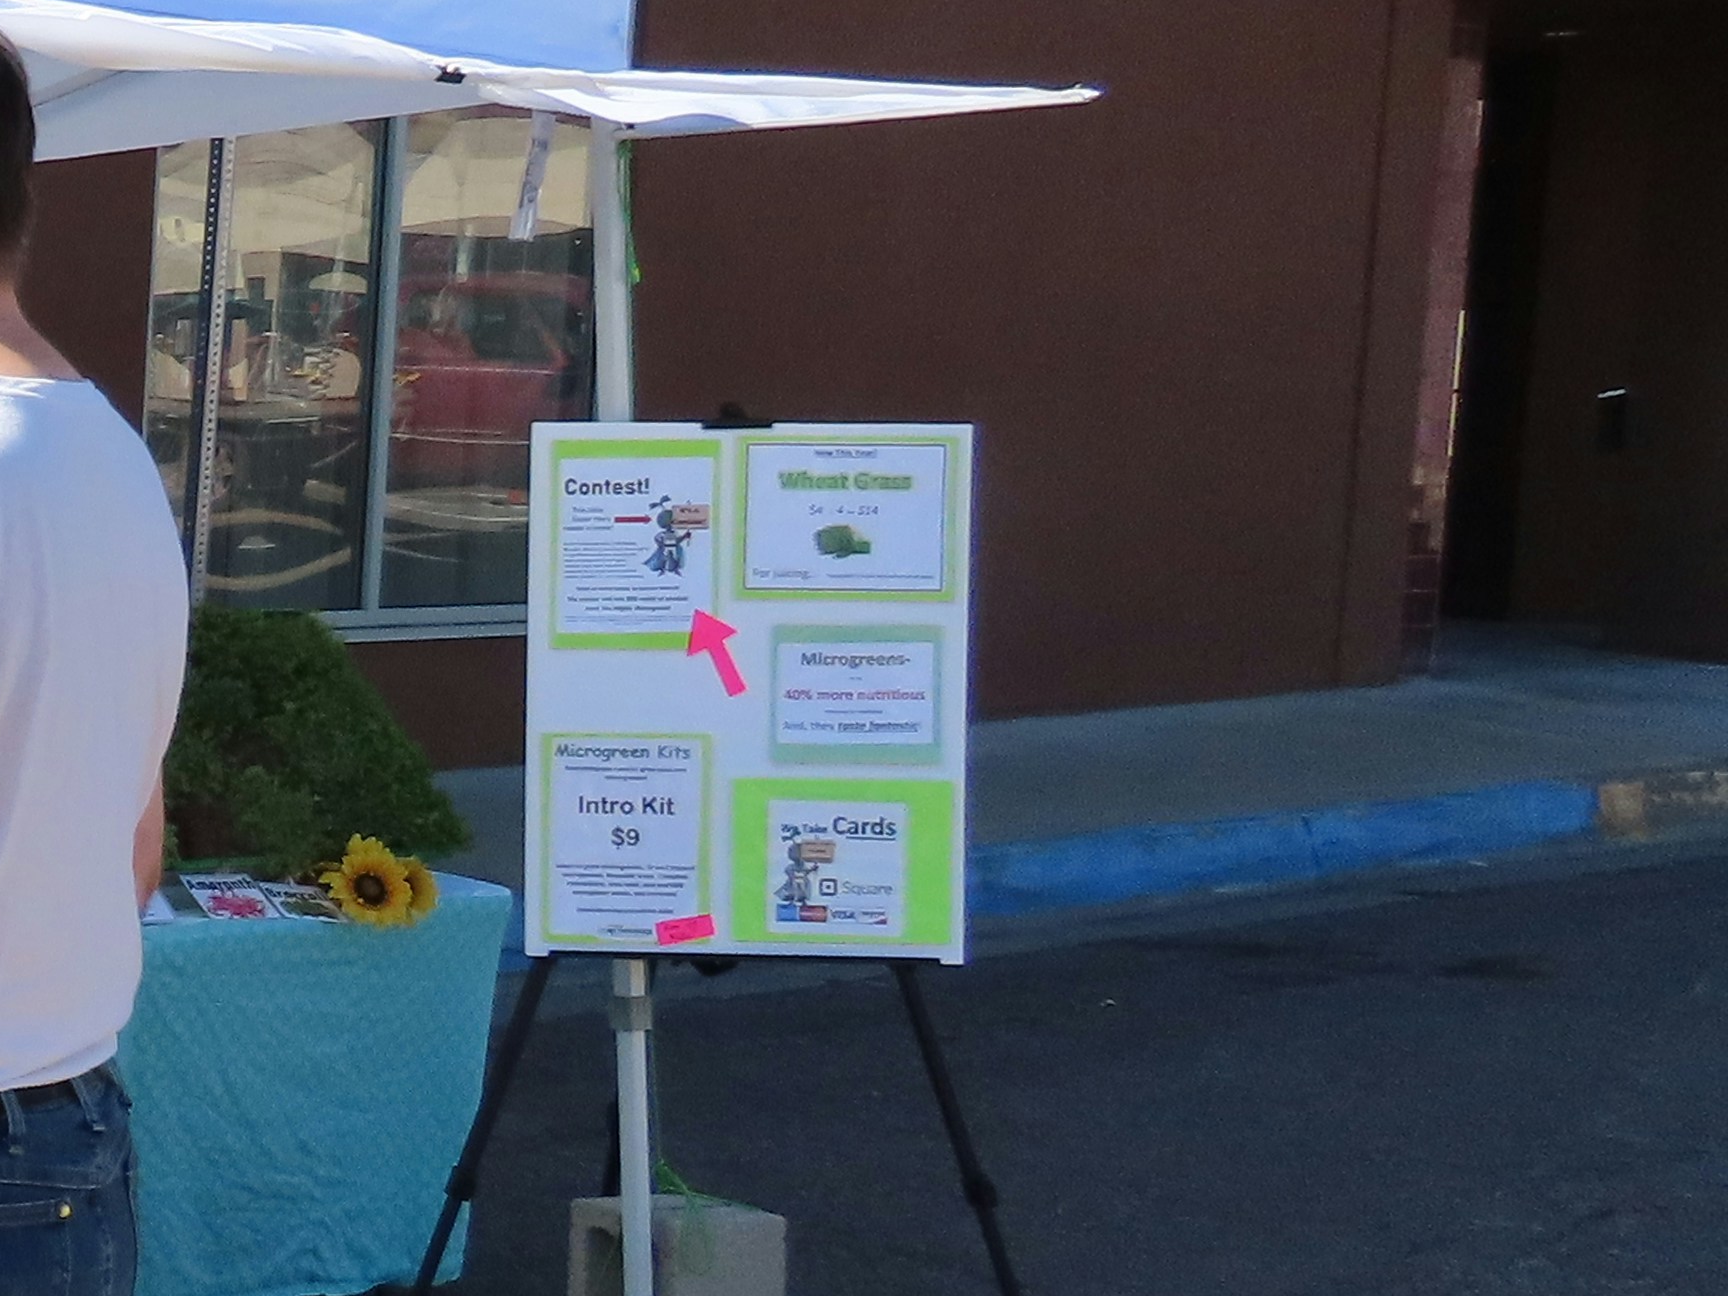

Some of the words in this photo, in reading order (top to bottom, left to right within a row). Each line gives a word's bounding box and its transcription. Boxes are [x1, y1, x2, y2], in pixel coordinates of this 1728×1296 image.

[564, 478, 650, 496] Contest!
[778, 470, 849, 490] Wheat
[854, 472, 913, 490] Grass
[816, 690, 854, 701] more
[554, 744, 650, 762] Microgreen
[657, 745, 692, 760] Kits
[578, 795, 635, 815] Intro
[641, 796, 676, 816] Kit
[832, 815, 898, 837] Cards
[611, 826, 640, 850] $9
[185, 877, 258, 892] Amaranth
[842, 881, 893, 896] Square
